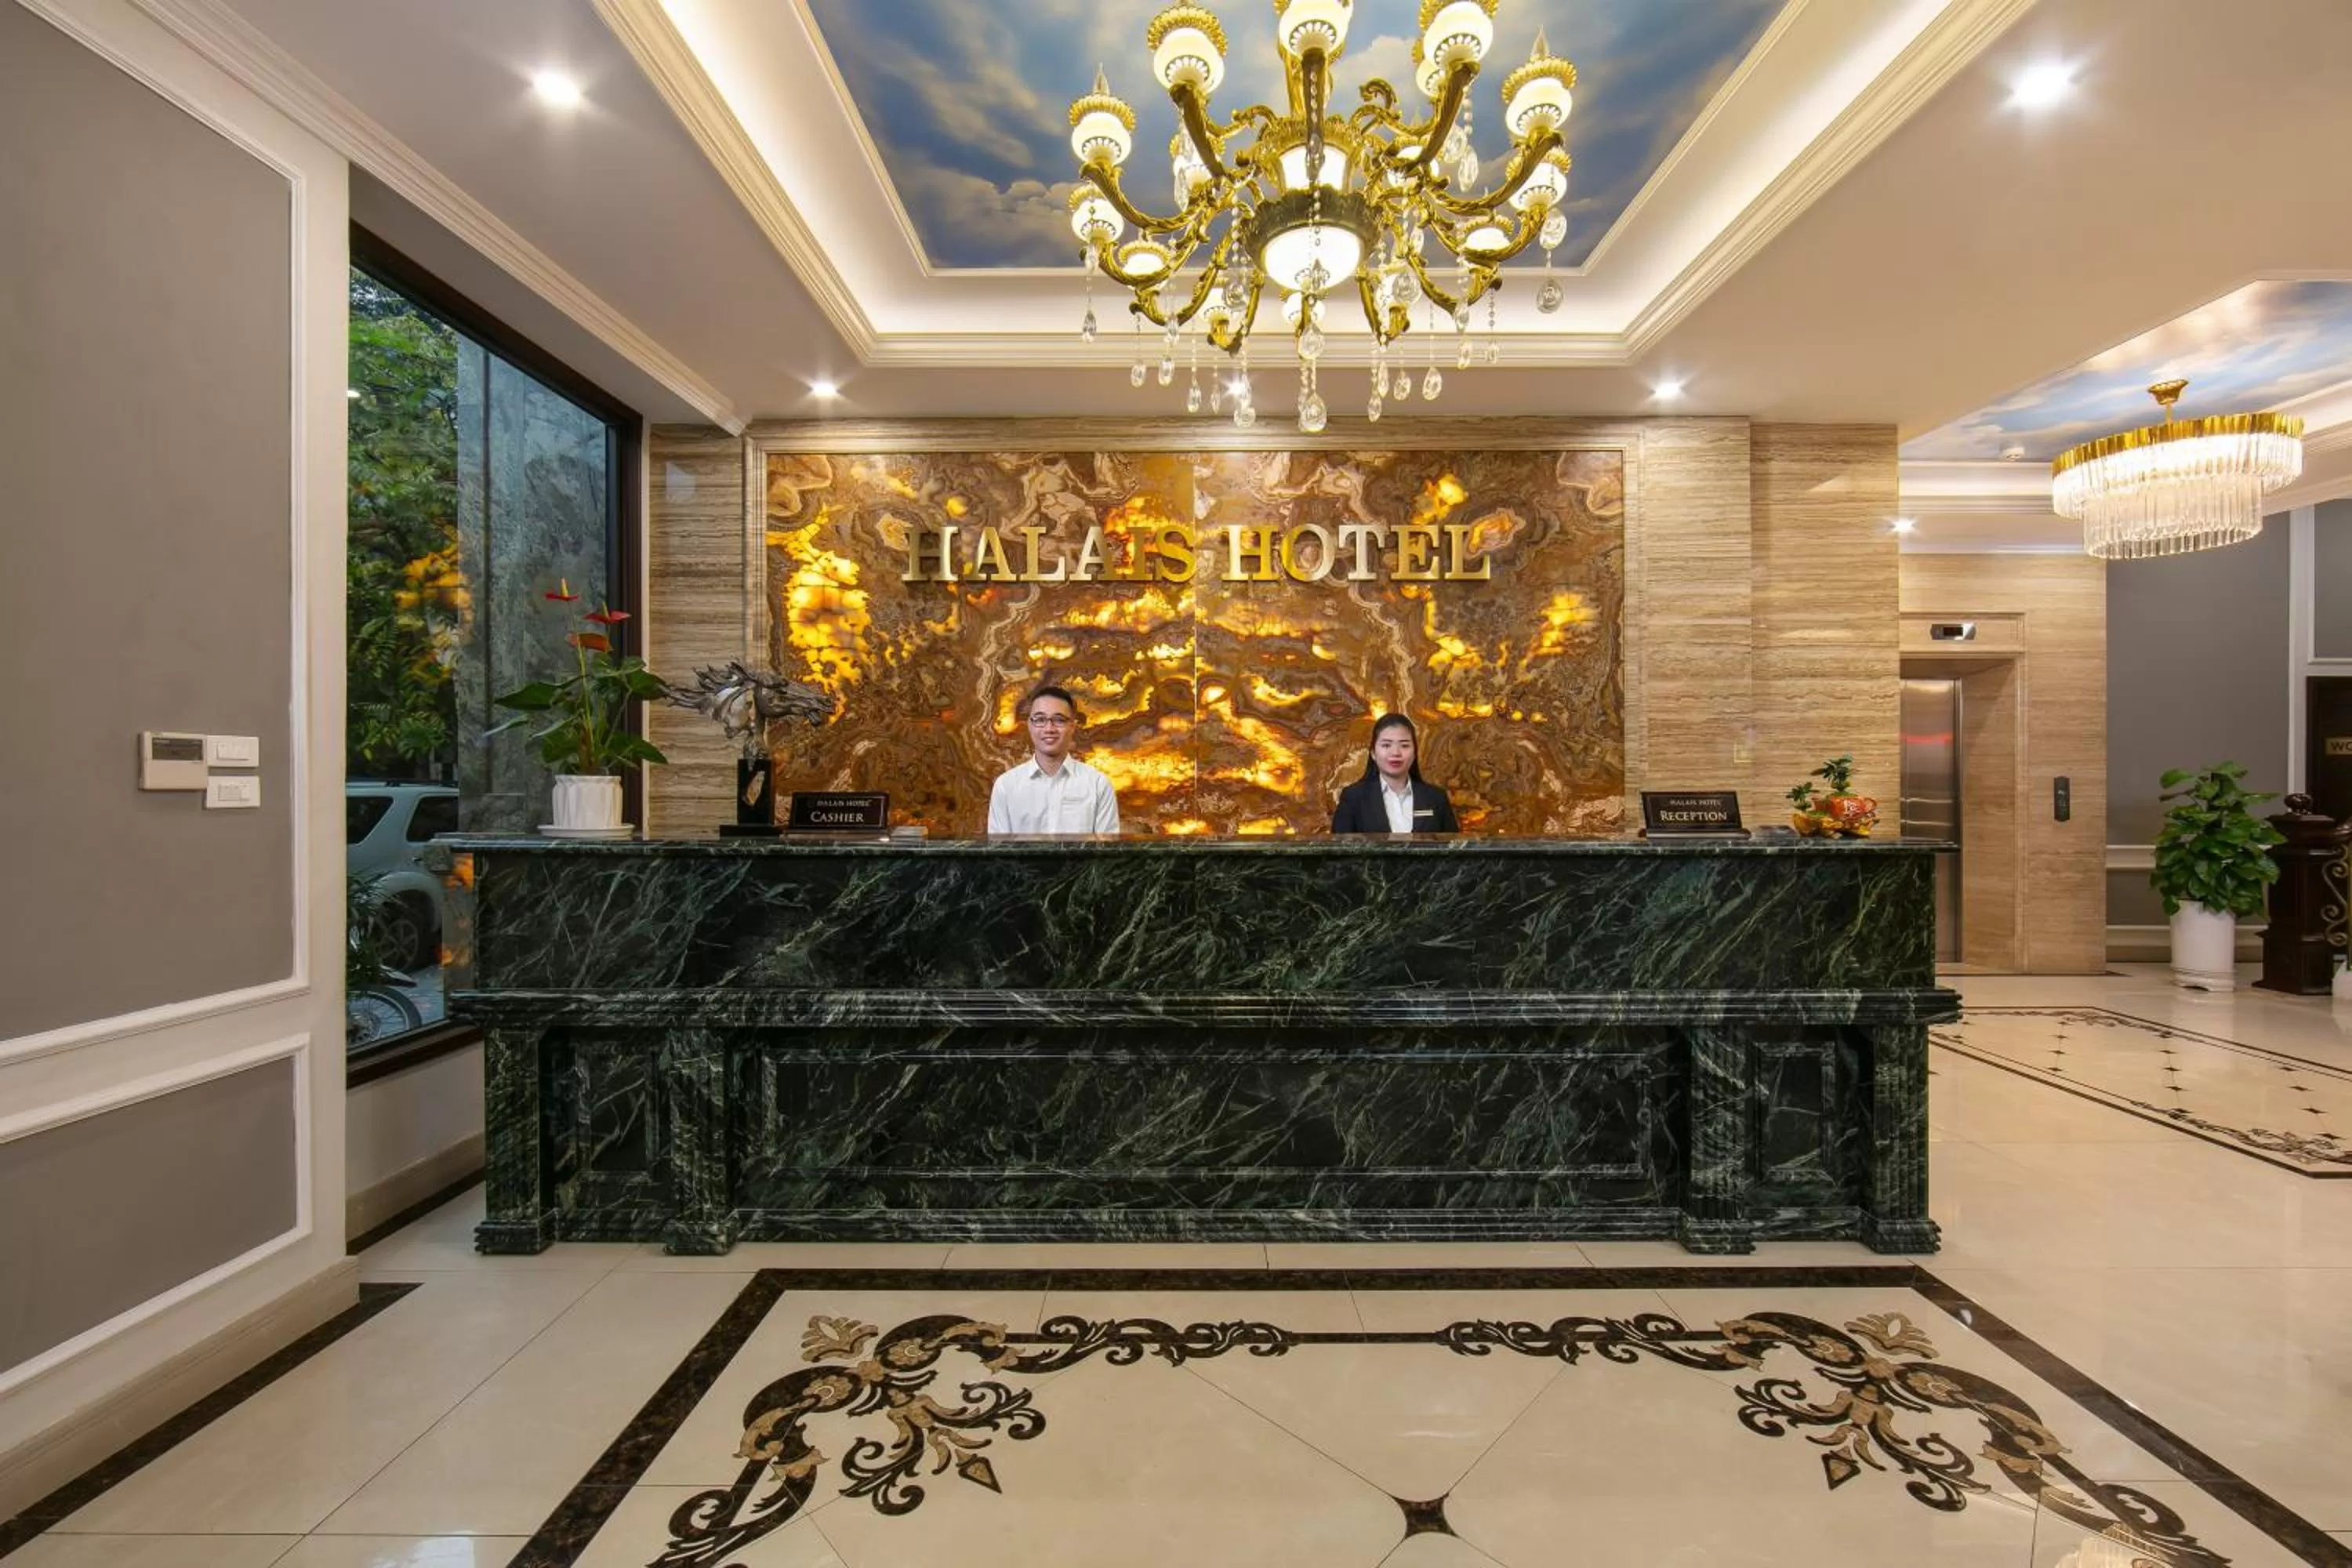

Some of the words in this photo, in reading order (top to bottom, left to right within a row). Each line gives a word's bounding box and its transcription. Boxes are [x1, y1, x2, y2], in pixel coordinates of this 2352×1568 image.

[902, 525, 1196, 582] HALAIS
[1221, 524, 1490, 582] HOTEL
[810, 811, 865, 822] CASHIER
[1660, 810, 1727, 821] RECEPTION
